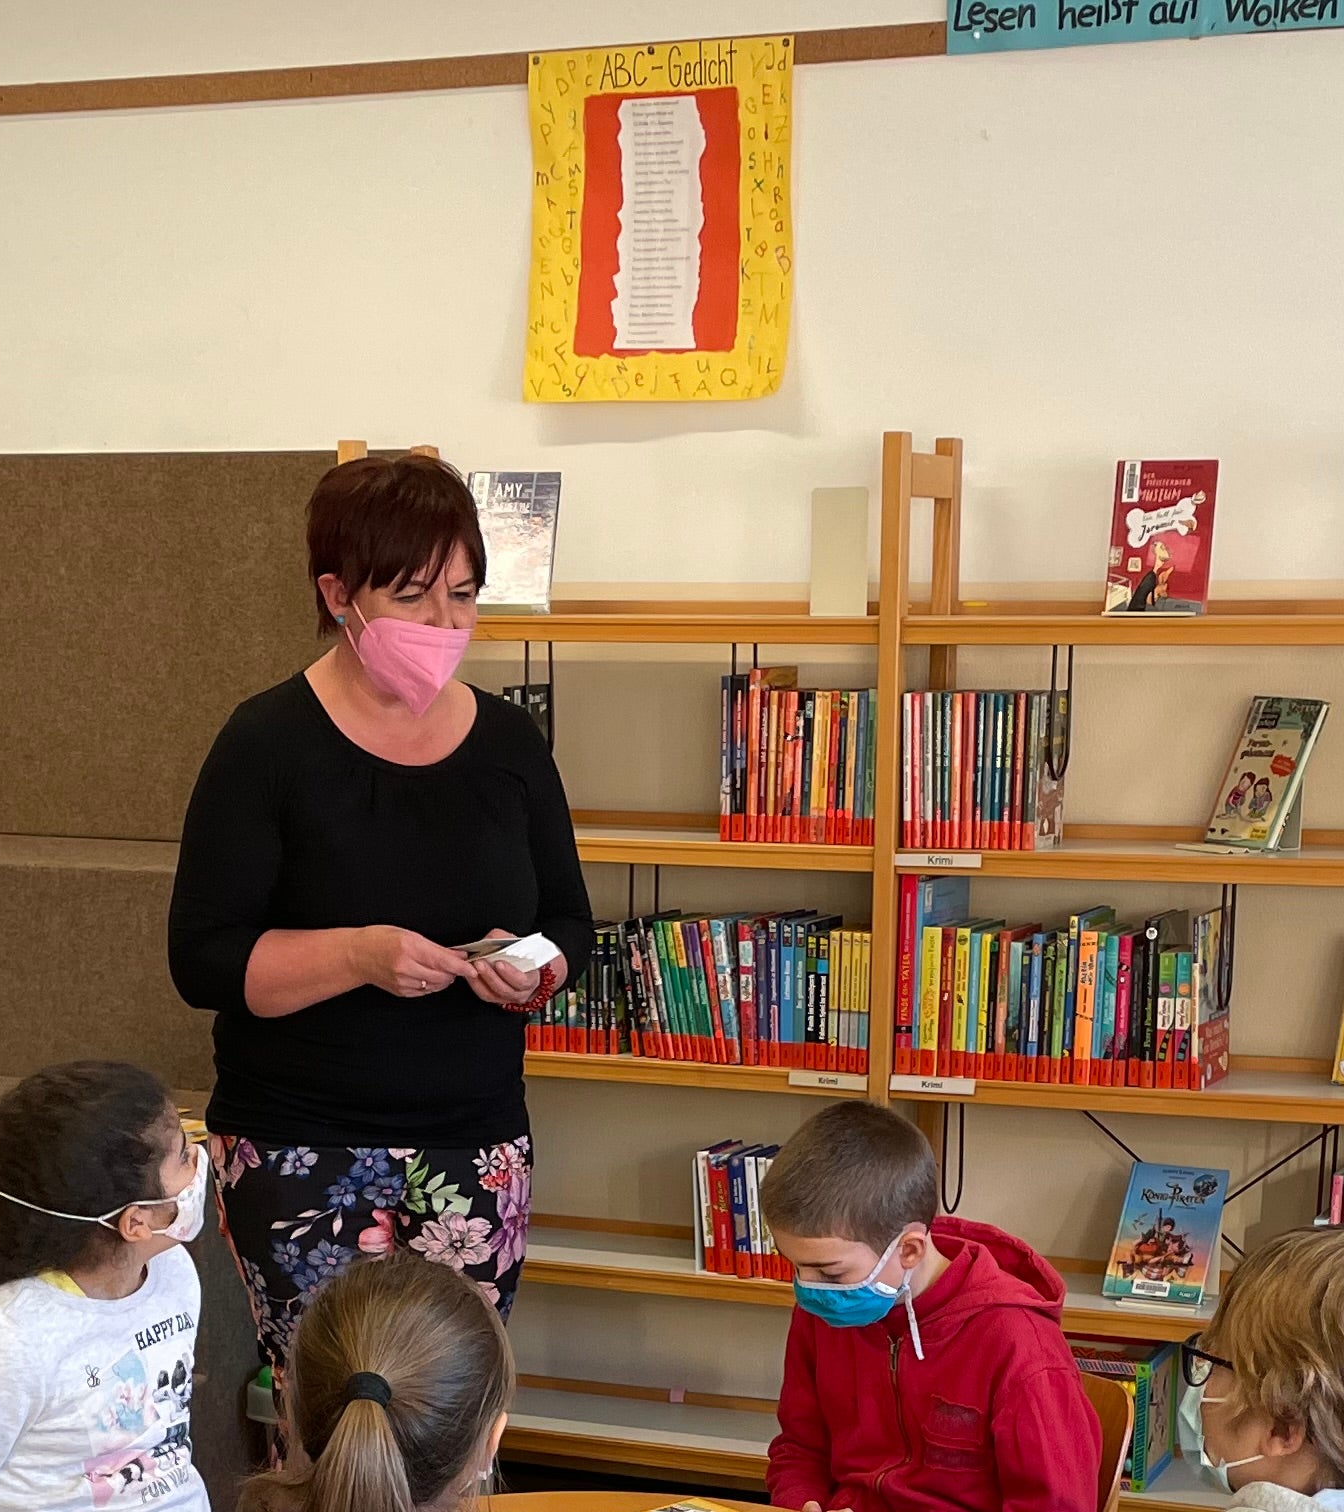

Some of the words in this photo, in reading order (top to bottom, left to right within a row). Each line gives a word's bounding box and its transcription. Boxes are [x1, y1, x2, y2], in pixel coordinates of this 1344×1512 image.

[954, 0, 1036, 32] Lesen
[494, 482, 523, 499] AMY
[926, 854, 954, 867] Krimi
[818, 1077, 838, 1086] Krimi
[921, 1080, 943, 1090] Krimi
[135, 1316, 174, 1351] HAPPY
[177, 1311, 195, 1332] DA
[140, 1475, 171, 1504] FUN
